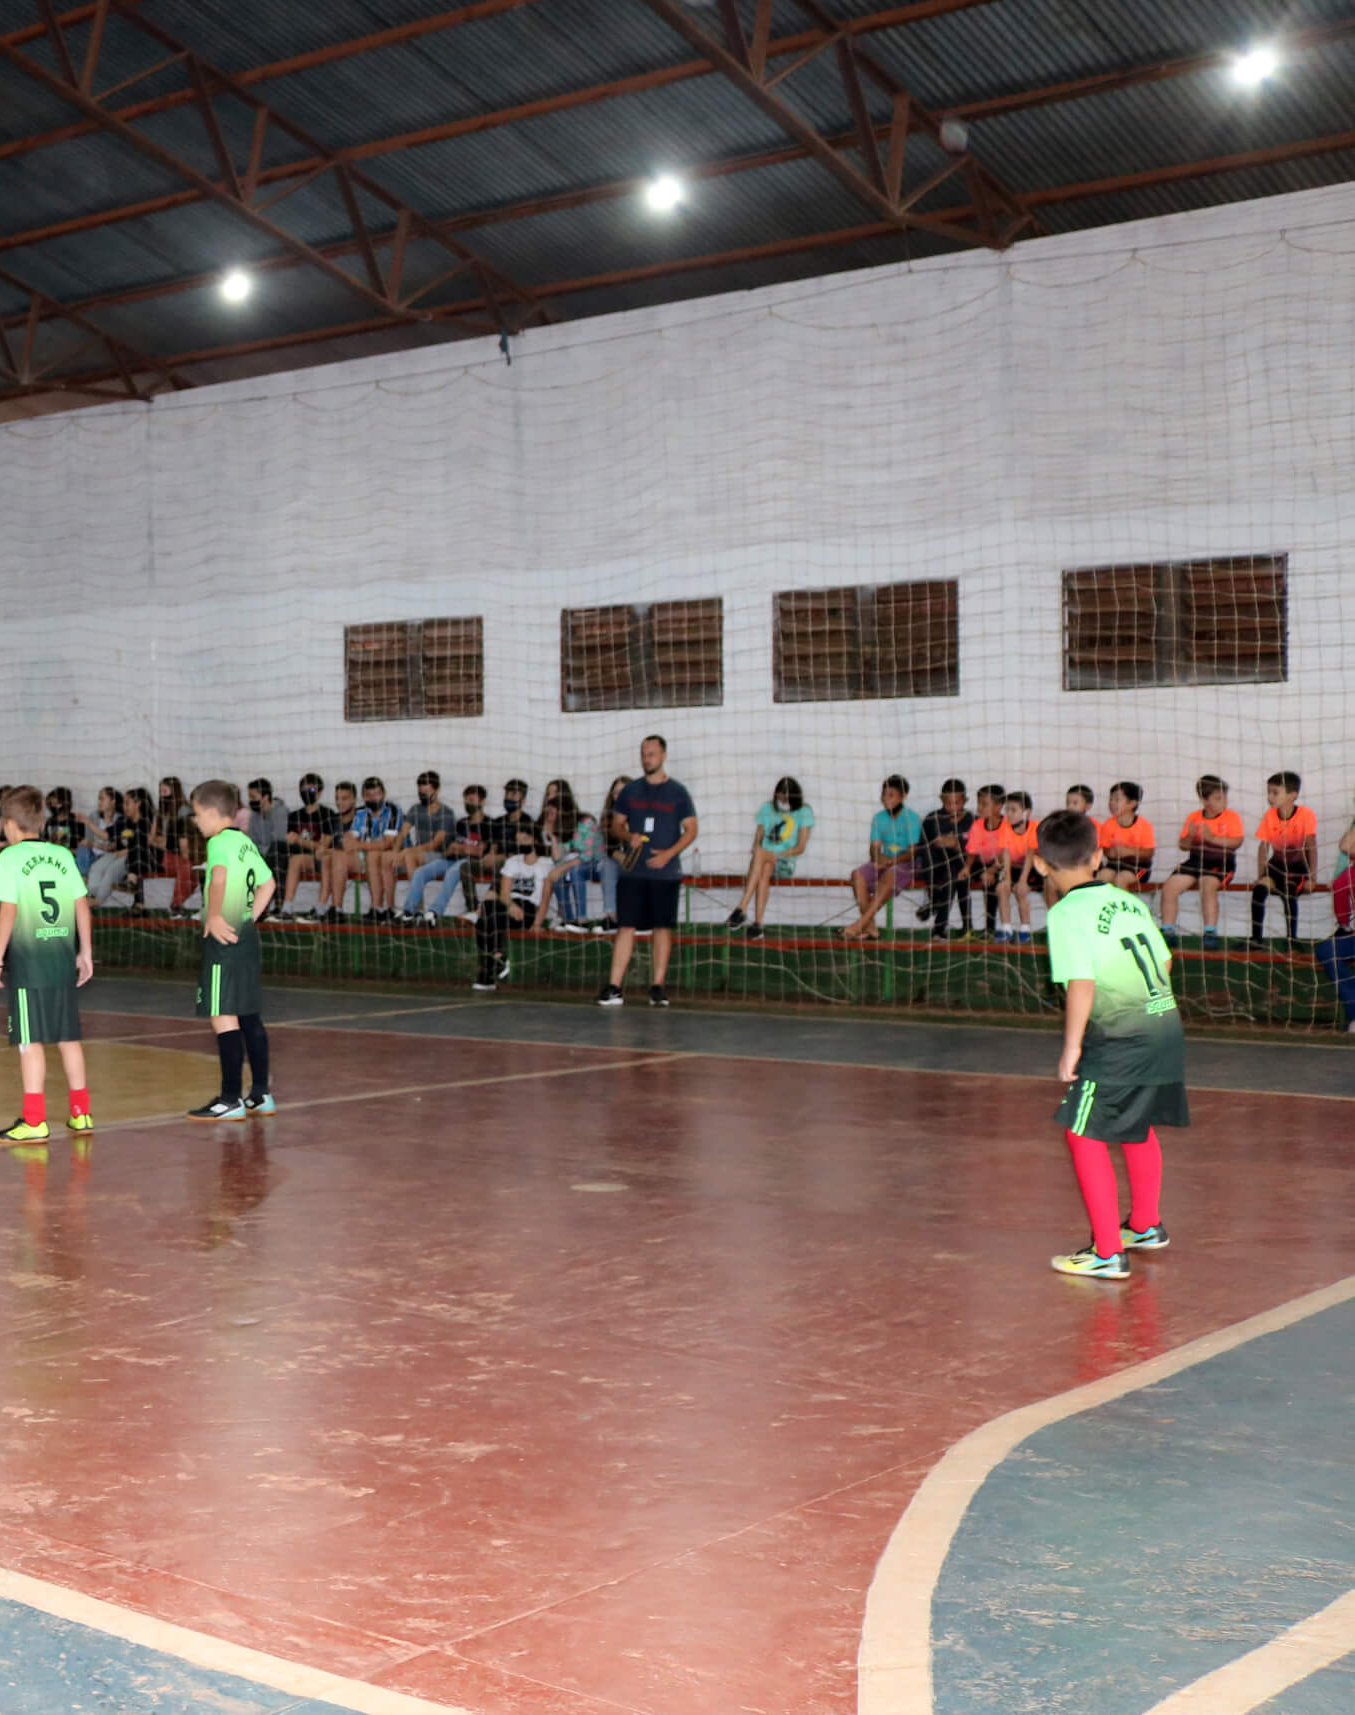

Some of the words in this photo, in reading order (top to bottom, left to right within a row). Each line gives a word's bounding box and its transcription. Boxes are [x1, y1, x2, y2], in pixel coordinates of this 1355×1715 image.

[38, 880, 61, 925] 5
[246, 868, 256, 909] 8
[1119, 932, 1168, 997] 11
